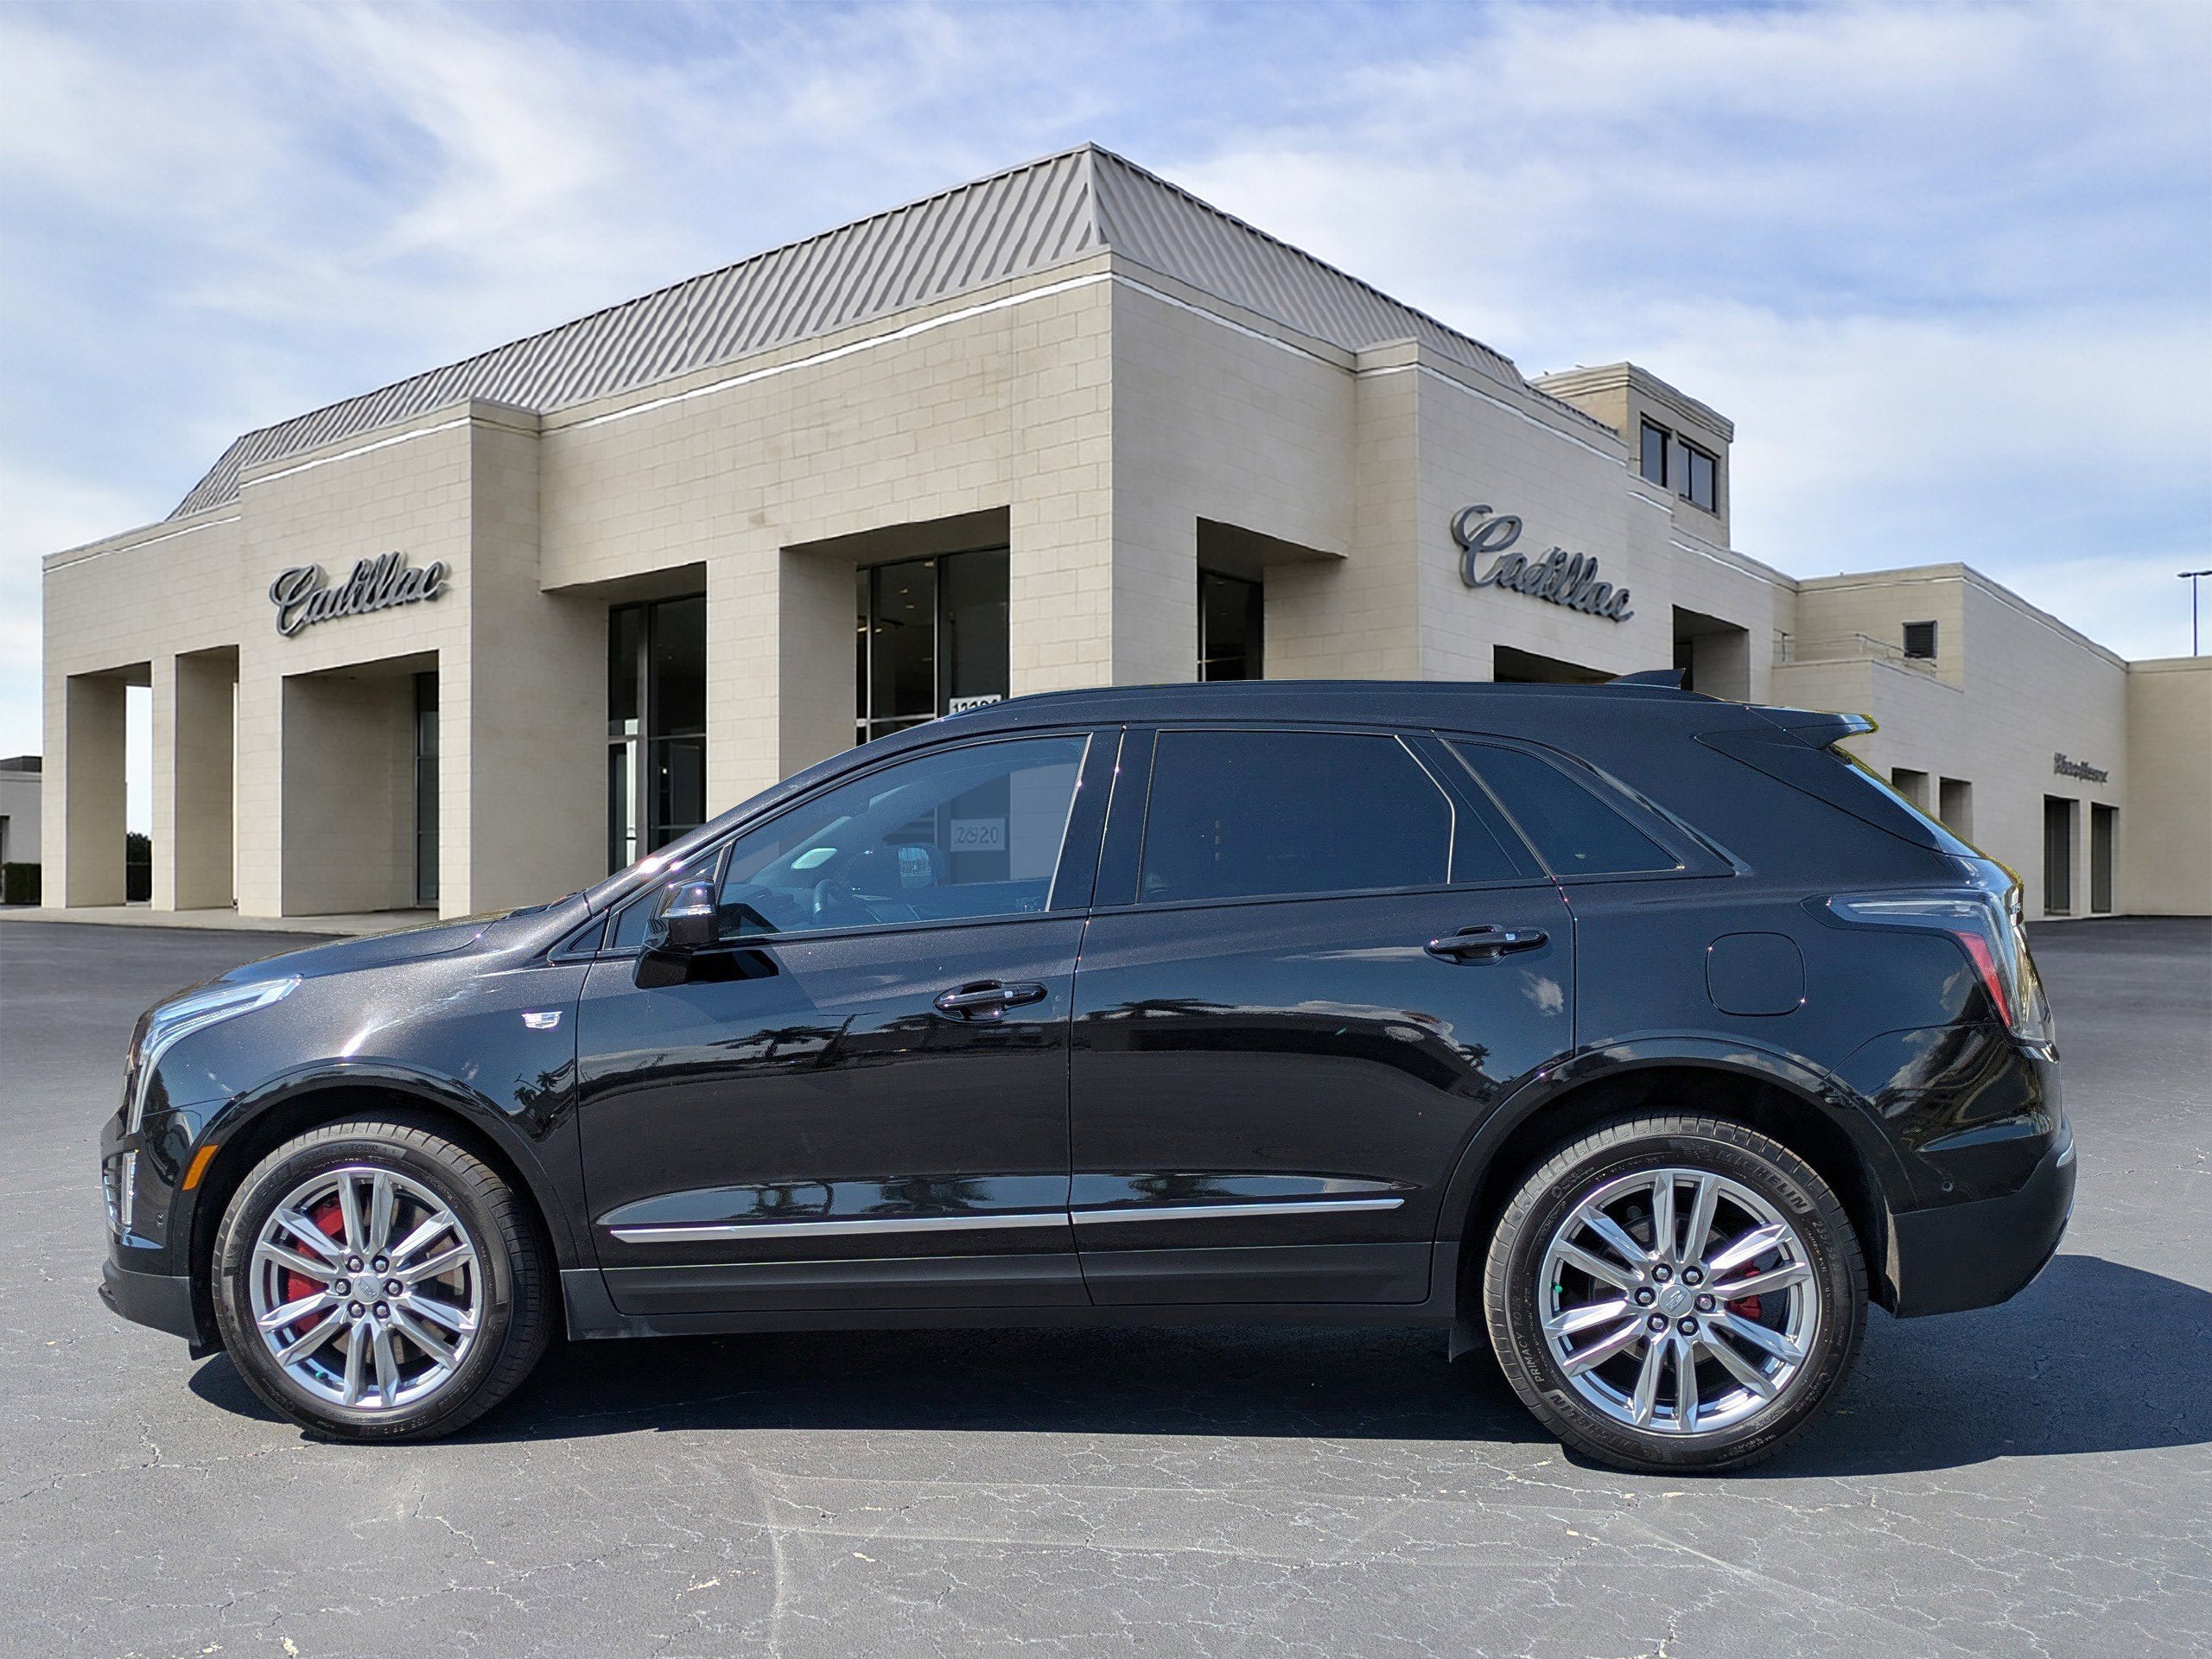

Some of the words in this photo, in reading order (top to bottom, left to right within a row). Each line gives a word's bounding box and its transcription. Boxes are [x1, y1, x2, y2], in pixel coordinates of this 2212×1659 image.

[269, 550, 452, 638] Cadillac
[1451, 504, 1634, 622] Cadillac
[1517, 1332, 1545, 1383] PRIMACY
